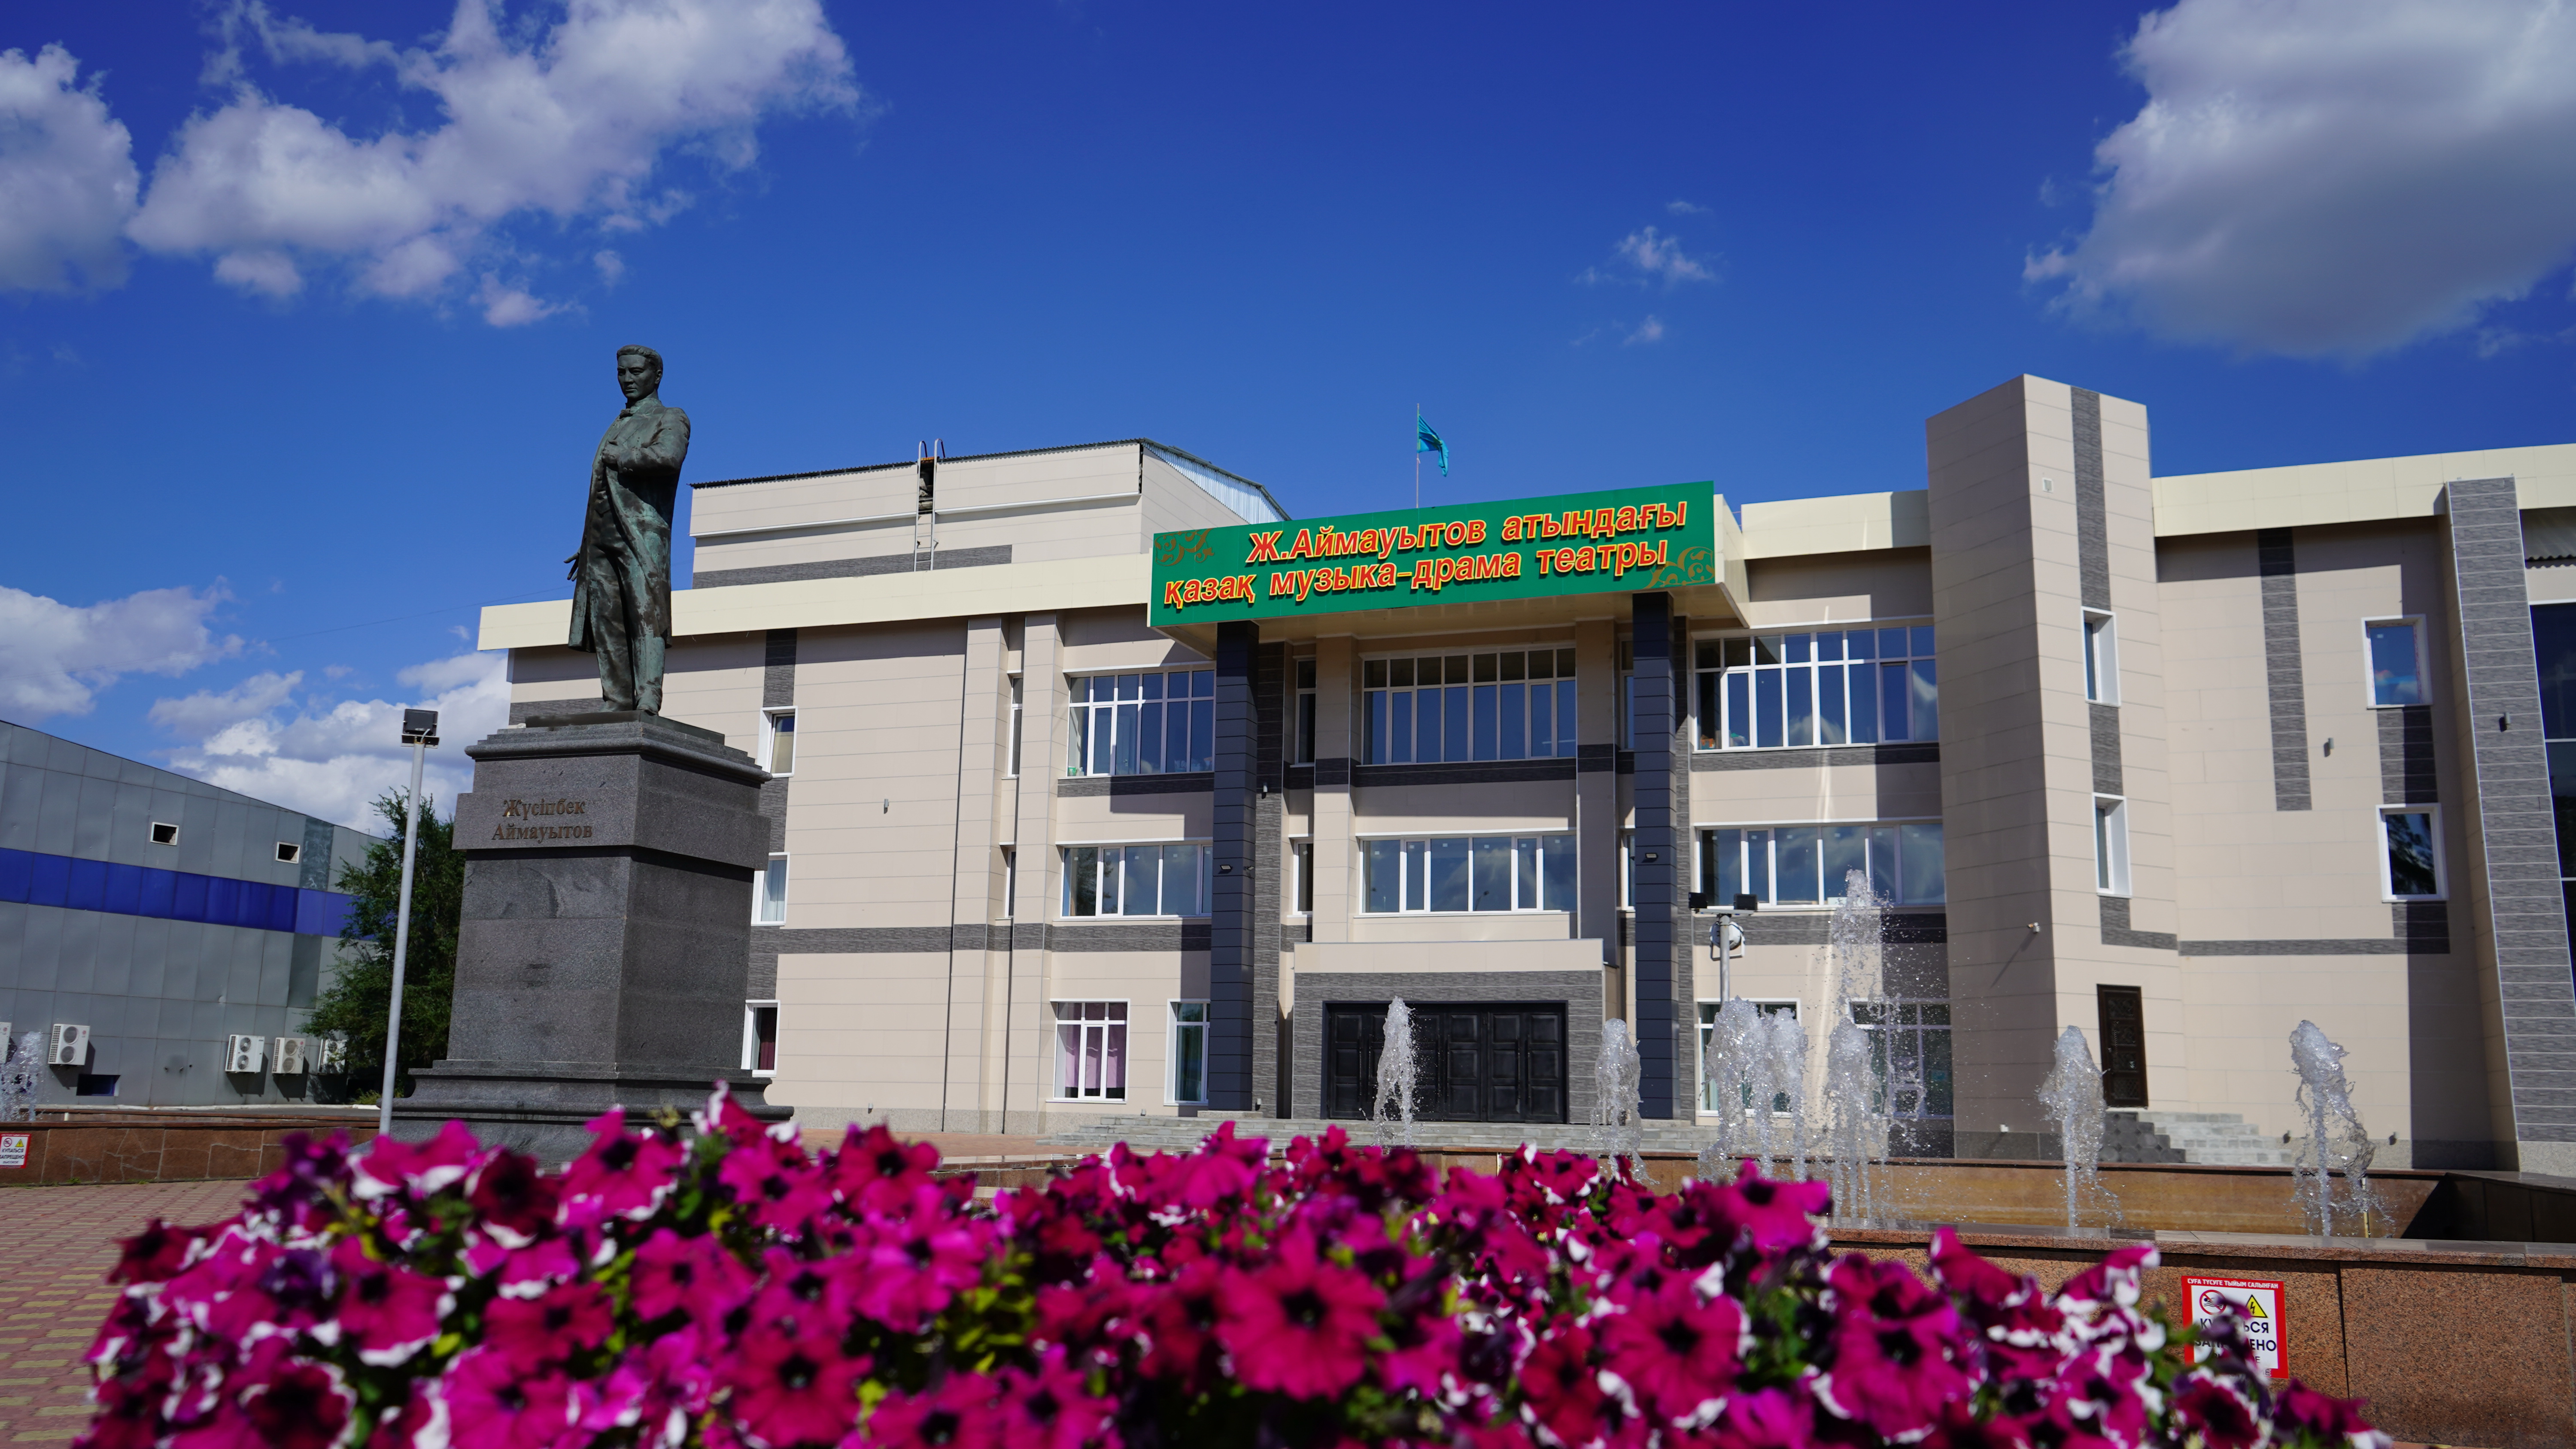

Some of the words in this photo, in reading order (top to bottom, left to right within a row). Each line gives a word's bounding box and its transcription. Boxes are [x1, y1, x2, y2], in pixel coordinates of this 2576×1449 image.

[1245, 519, 1486, 563] Ж.Аймауытов
[1502, 501, 1687, 541] атындағы
[1164, 573, 1257, 609] қазақ
[1536, 540, 1668, 576] театры
[502, 798, 586, 821] Жүсіпбек
[491, 823, 593, 844] Аймауытов
